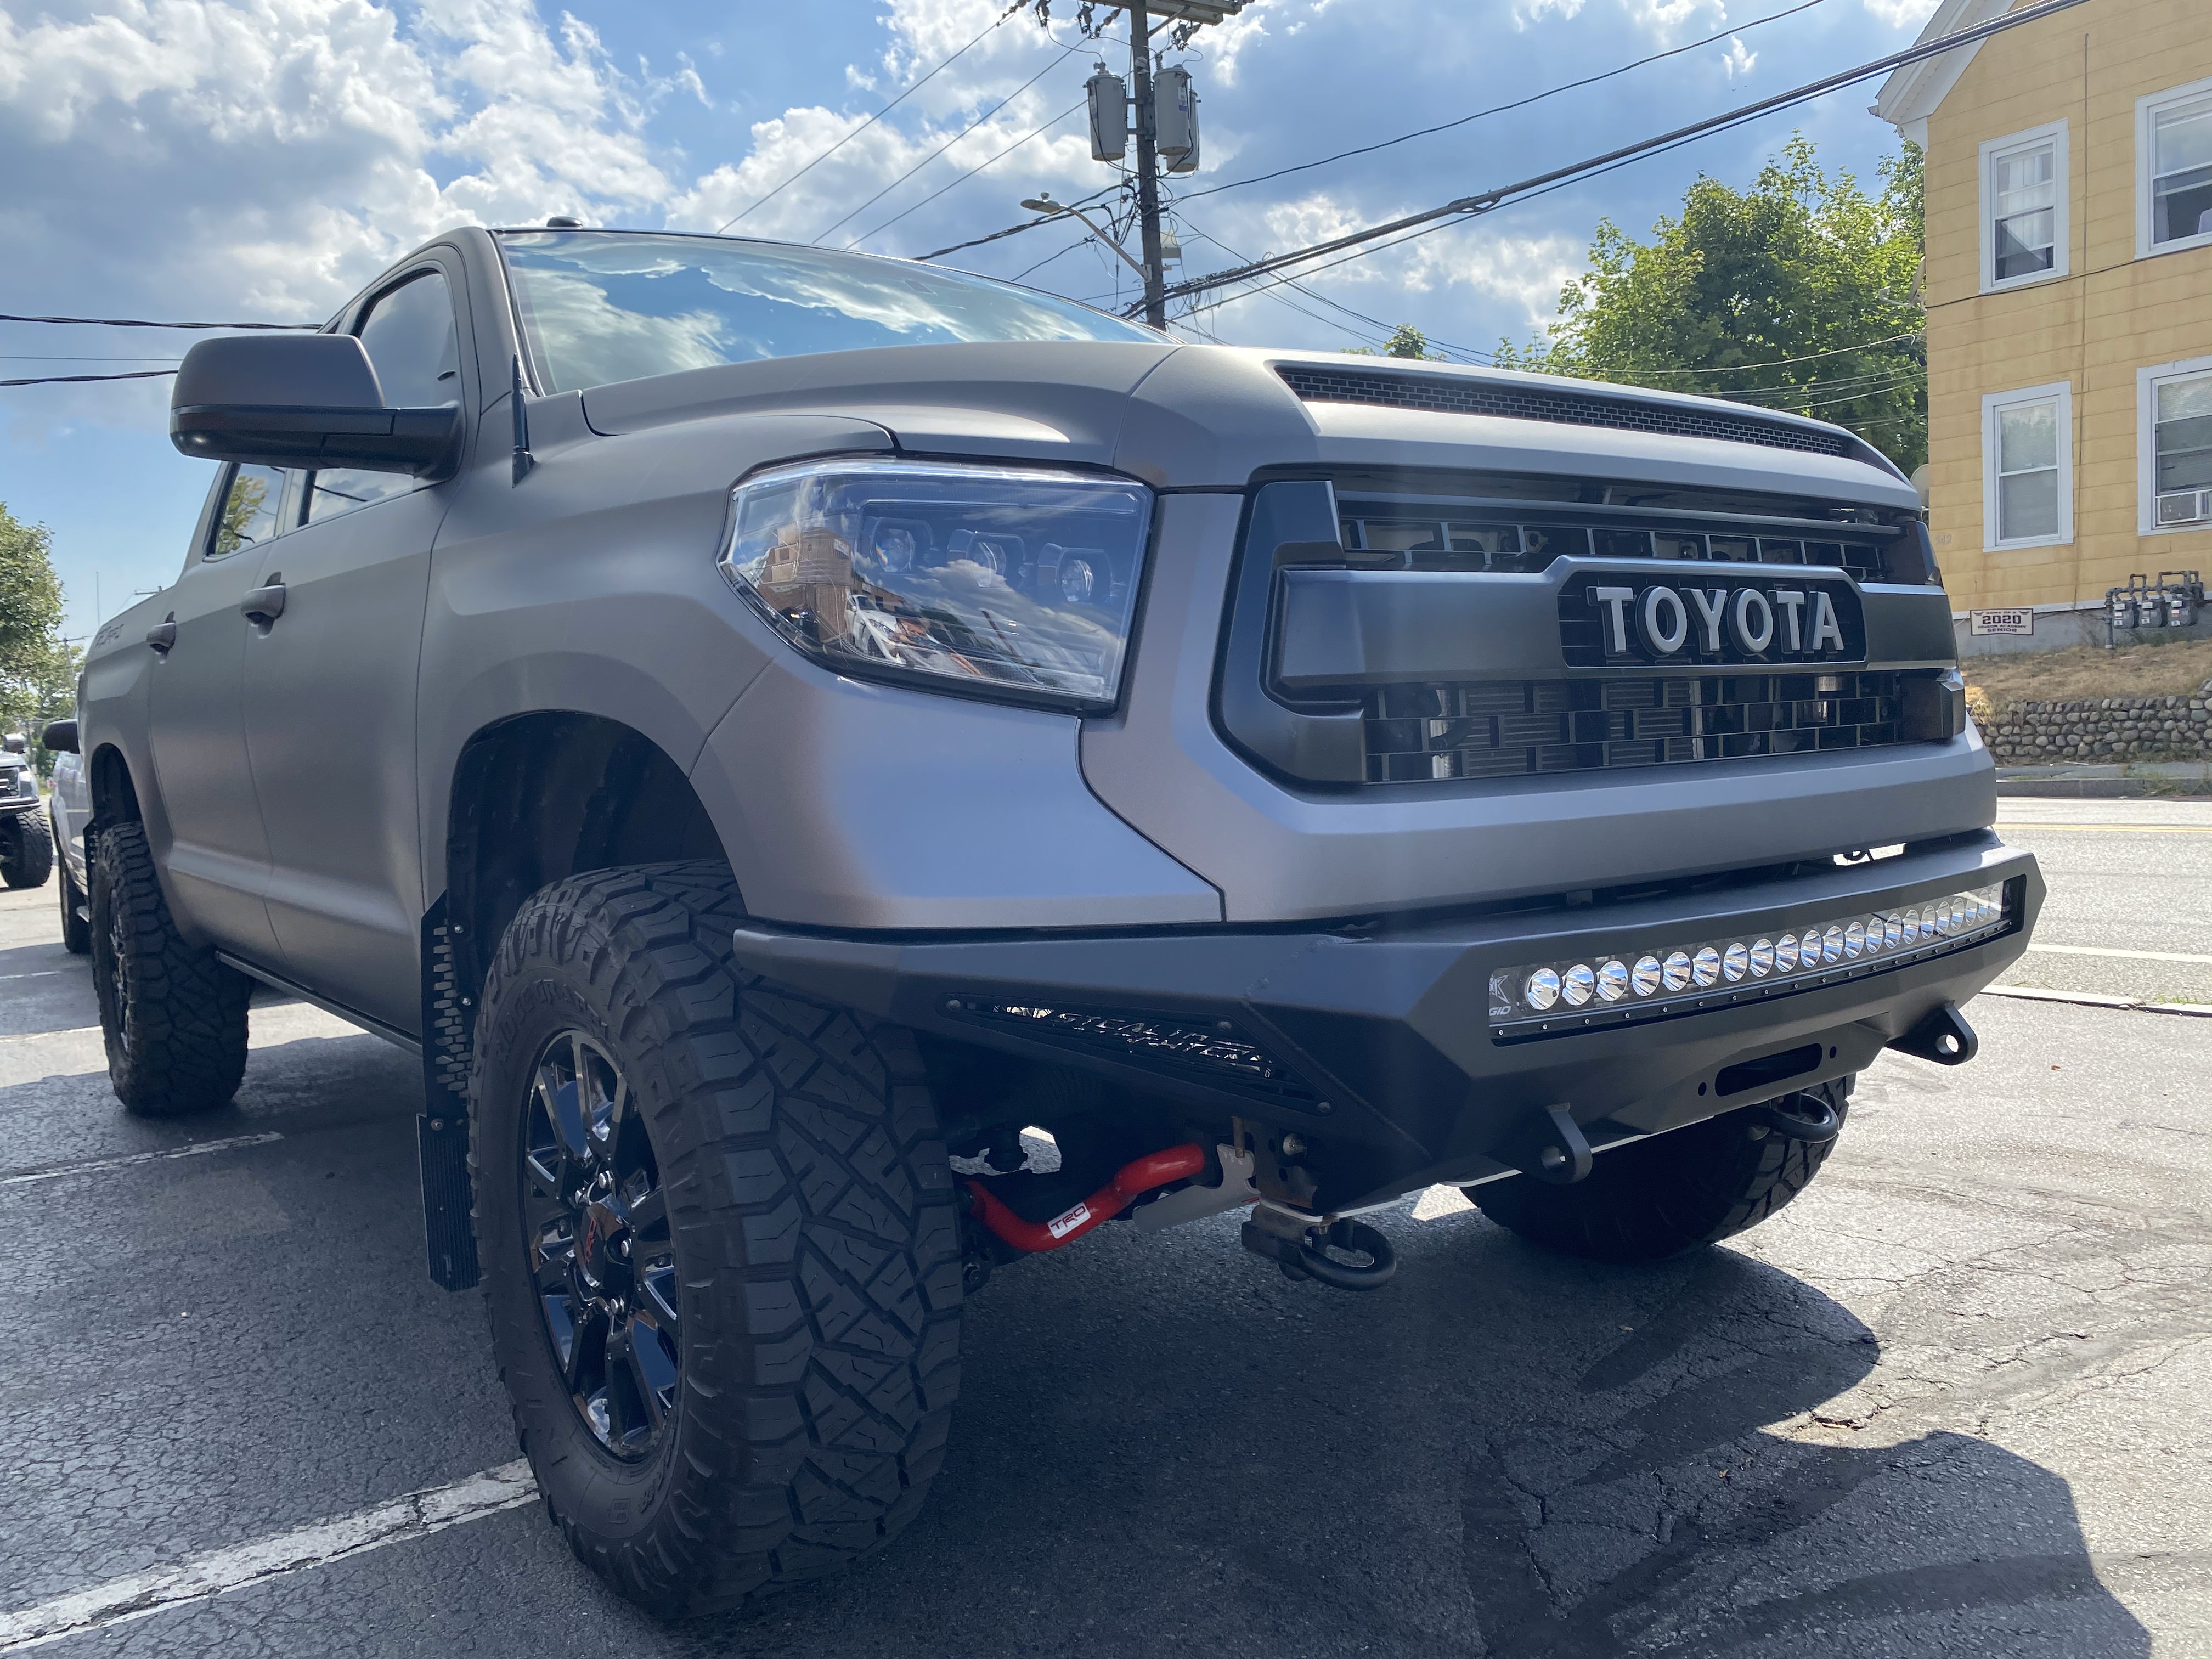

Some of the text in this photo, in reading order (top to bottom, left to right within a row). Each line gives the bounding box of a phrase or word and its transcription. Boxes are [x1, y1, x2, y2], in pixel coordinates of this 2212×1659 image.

[1592, 585, 1845, 654] TOYOTA
[1982, 615, 2022, 624] 2020
[1050, 1205, 1086, 1230] TRD
